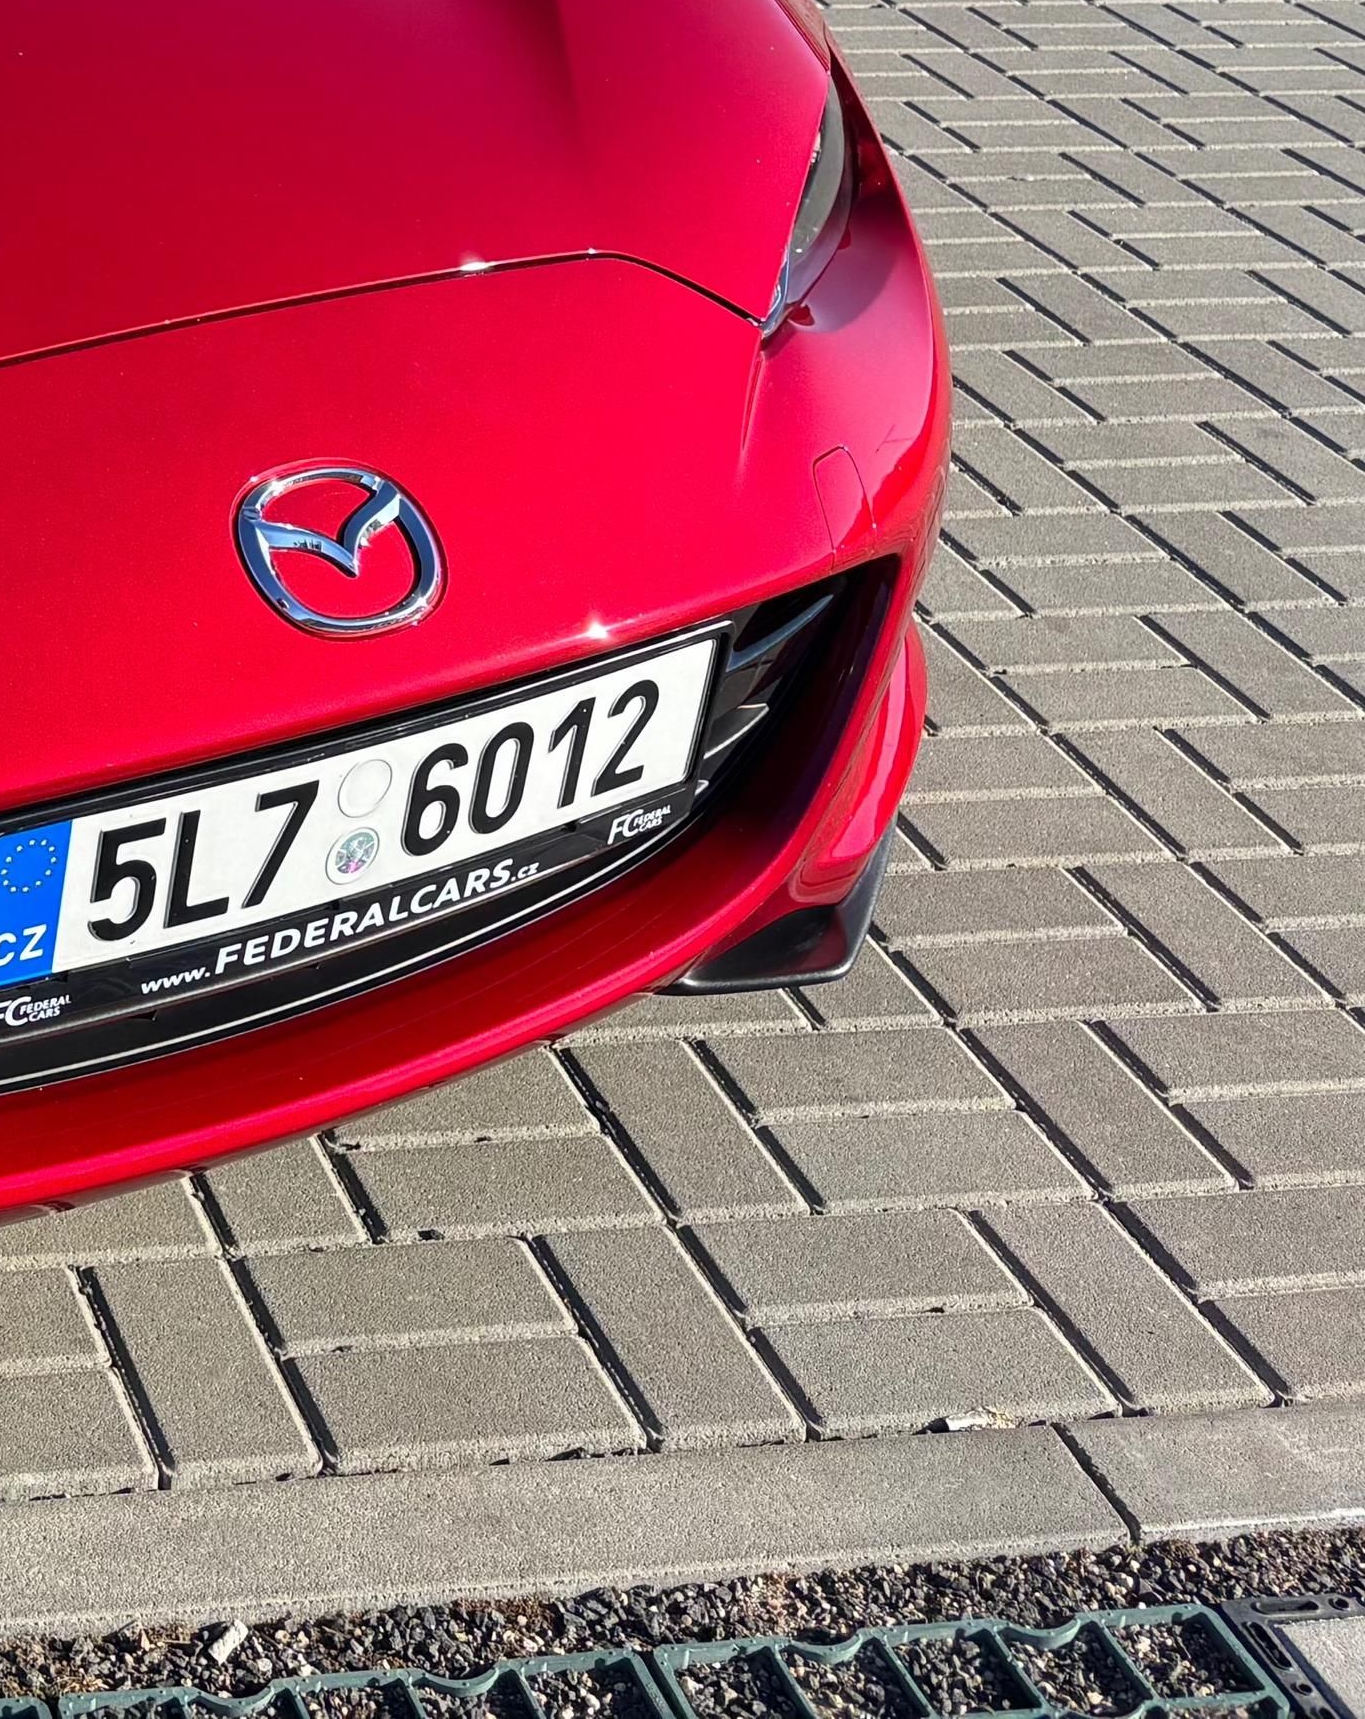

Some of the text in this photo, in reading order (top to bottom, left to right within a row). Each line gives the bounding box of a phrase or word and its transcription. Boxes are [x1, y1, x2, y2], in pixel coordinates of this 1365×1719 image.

[87, 679, 660, 942] 5L7 6012
[140, 858, 541, 994] www.FEDERALCARS.cz
[19, 994, 72, 1016] FEDERAL
[28, 1006, 61, 1022] CARS
